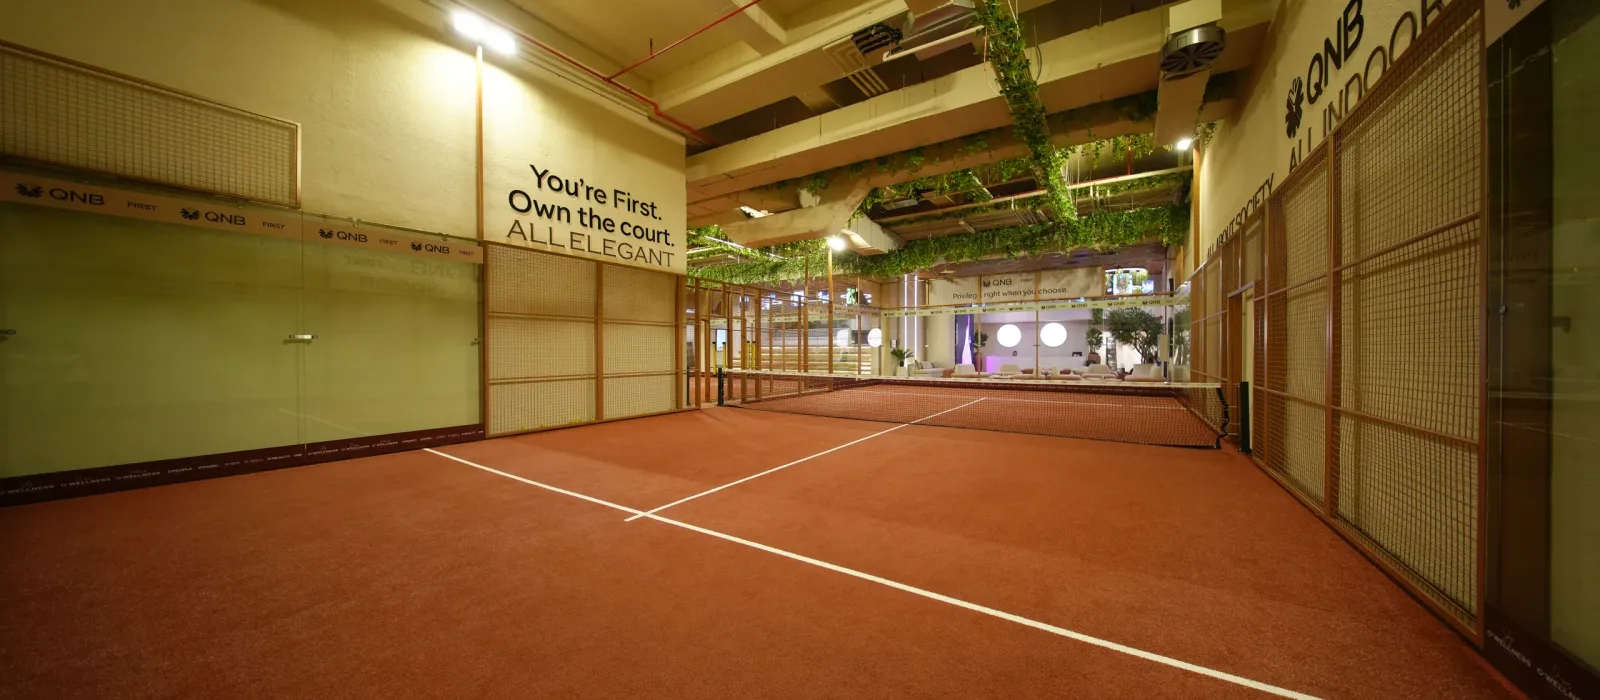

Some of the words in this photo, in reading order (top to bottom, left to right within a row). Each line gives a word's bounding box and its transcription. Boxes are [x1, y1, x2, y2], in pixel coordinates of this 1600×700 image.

[1306, 0, 1365, 105] QNB
[49, 187, 105, 206] QNB
[127, 200, 158, 212] FIRST
[613, 188, 662, 221] First.
[204, 210, 246, 226] QNB
[508, 189, 571, 224] Own
[577, 206, 616, 233] the
[620, 221, 675, 248] court.
[262, 221, 285, 230] FIRST
[336, 230, 368, 243] QNB
[379, 237, 398, 246] FIRST
[424, 243, 450, 255] QNB
[506, 219, 565, 249] ALL
[569, 231, 675, 268] ELEGANT
[992, 278, 1012, 287] QNB
[984, 290, 1001, 299] right
[1002, 288, 1022, 297] when
[1022, 289, 1036, 297] you
[1037, 287, 1069, 295] choose.
